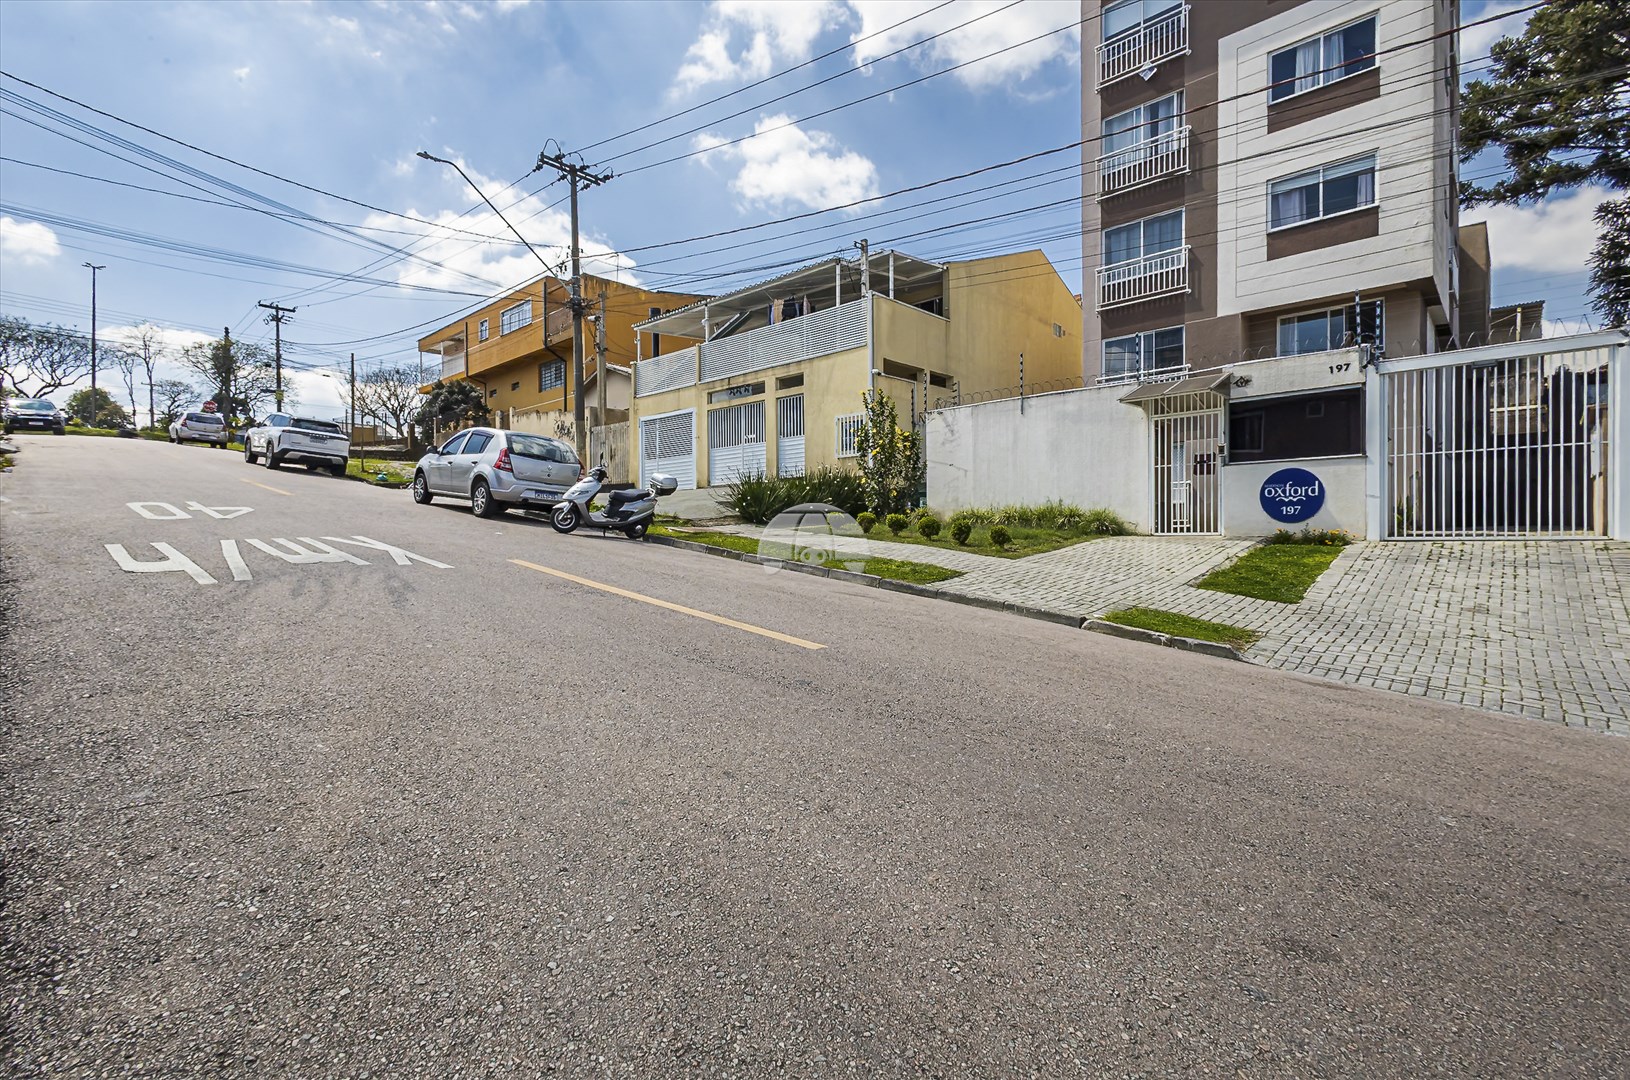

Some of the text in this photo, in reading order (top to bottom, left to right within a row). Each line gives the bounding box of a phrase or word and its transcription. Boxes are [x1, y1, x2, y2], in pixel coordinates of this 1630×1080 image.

[1328, 362, 1351, 375] 197
[1264, 480, 1319, 498] oxford
[125, 501, 255, 520] 40
[1280, 505, 1302, 515] 197
